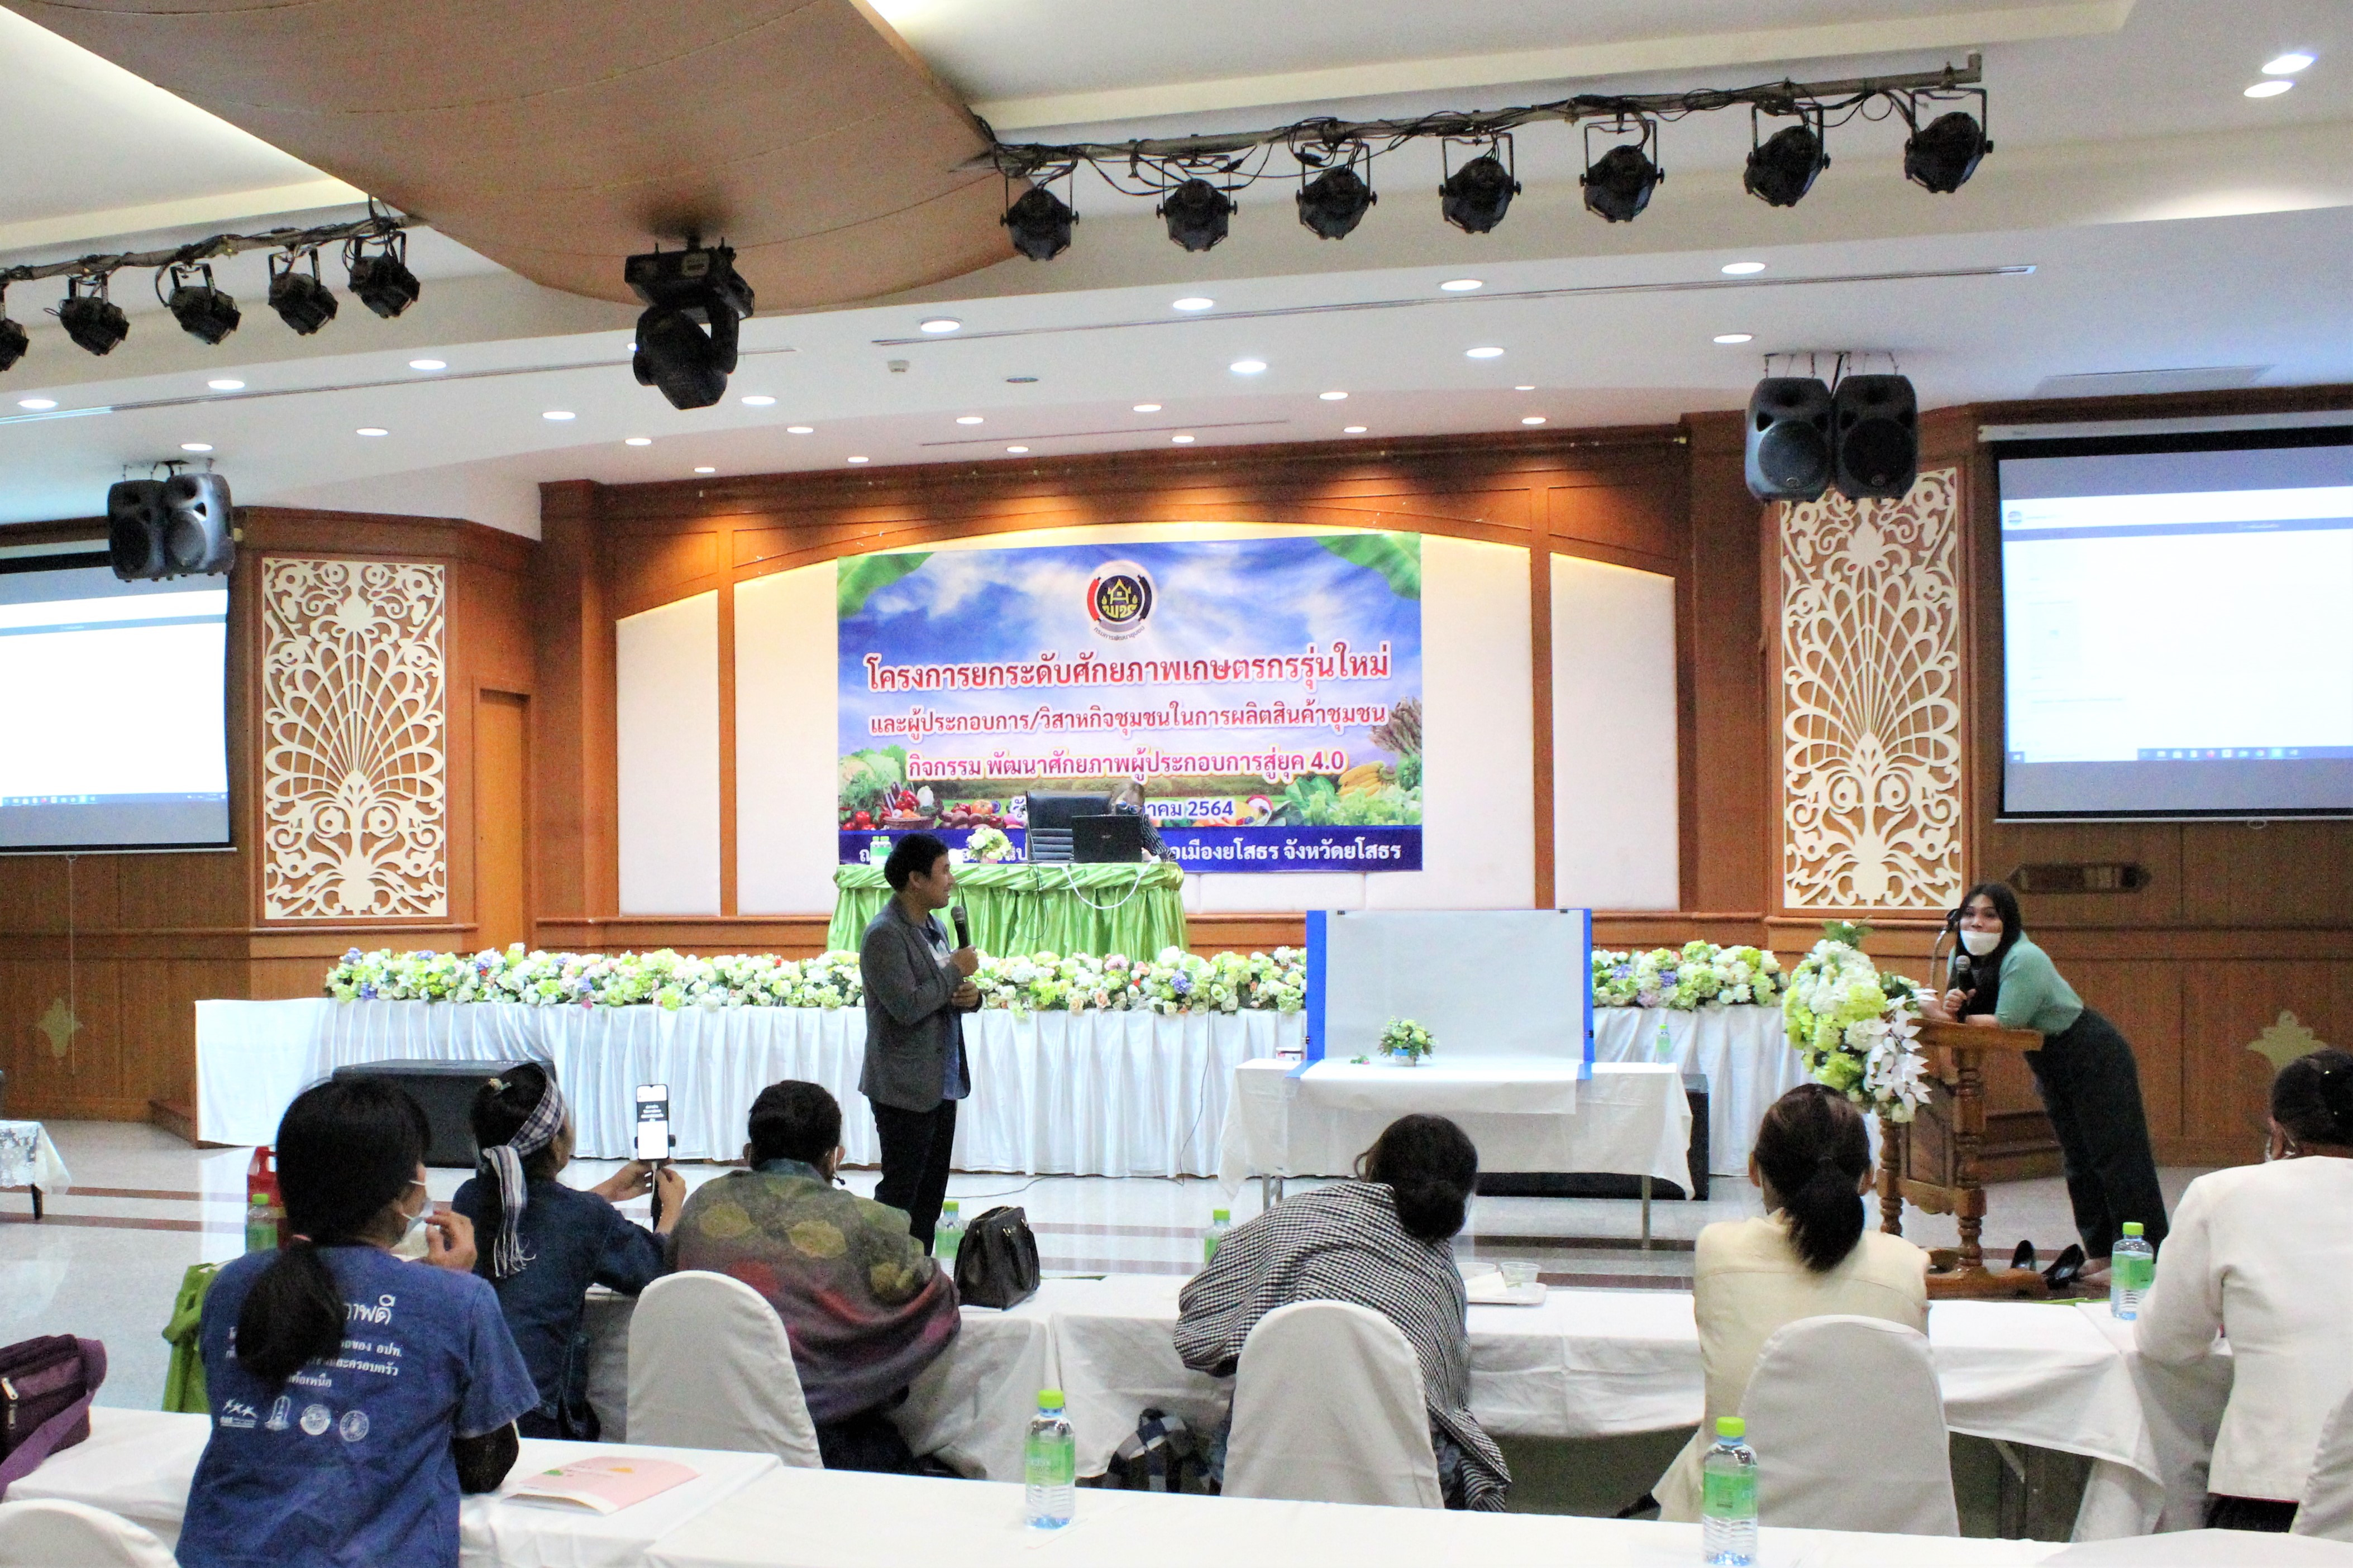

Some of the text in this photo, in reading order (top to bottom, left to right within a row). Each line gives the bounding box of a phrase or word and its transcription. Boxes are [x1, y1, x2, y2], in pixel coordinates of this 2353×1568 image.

[866, 642, 1388, 690] โครงการยกระดับศักยภาพเกษตรกรรุ่นใหม่
[871, 698, 1386, 740] และผู้ประกอบการ/วิสาหกิจชุมชนในการผลิตสินค้าชุมชน
[909, 747, 1344, 781] กิจกรรม พัฒนาศักยภาพผู้ประกอบการสู่ยุค 4.0
[1143, 800, 1234, 817] าคม 2564
[1283, 837, 1401, 861] จังหวัดยโสธร
